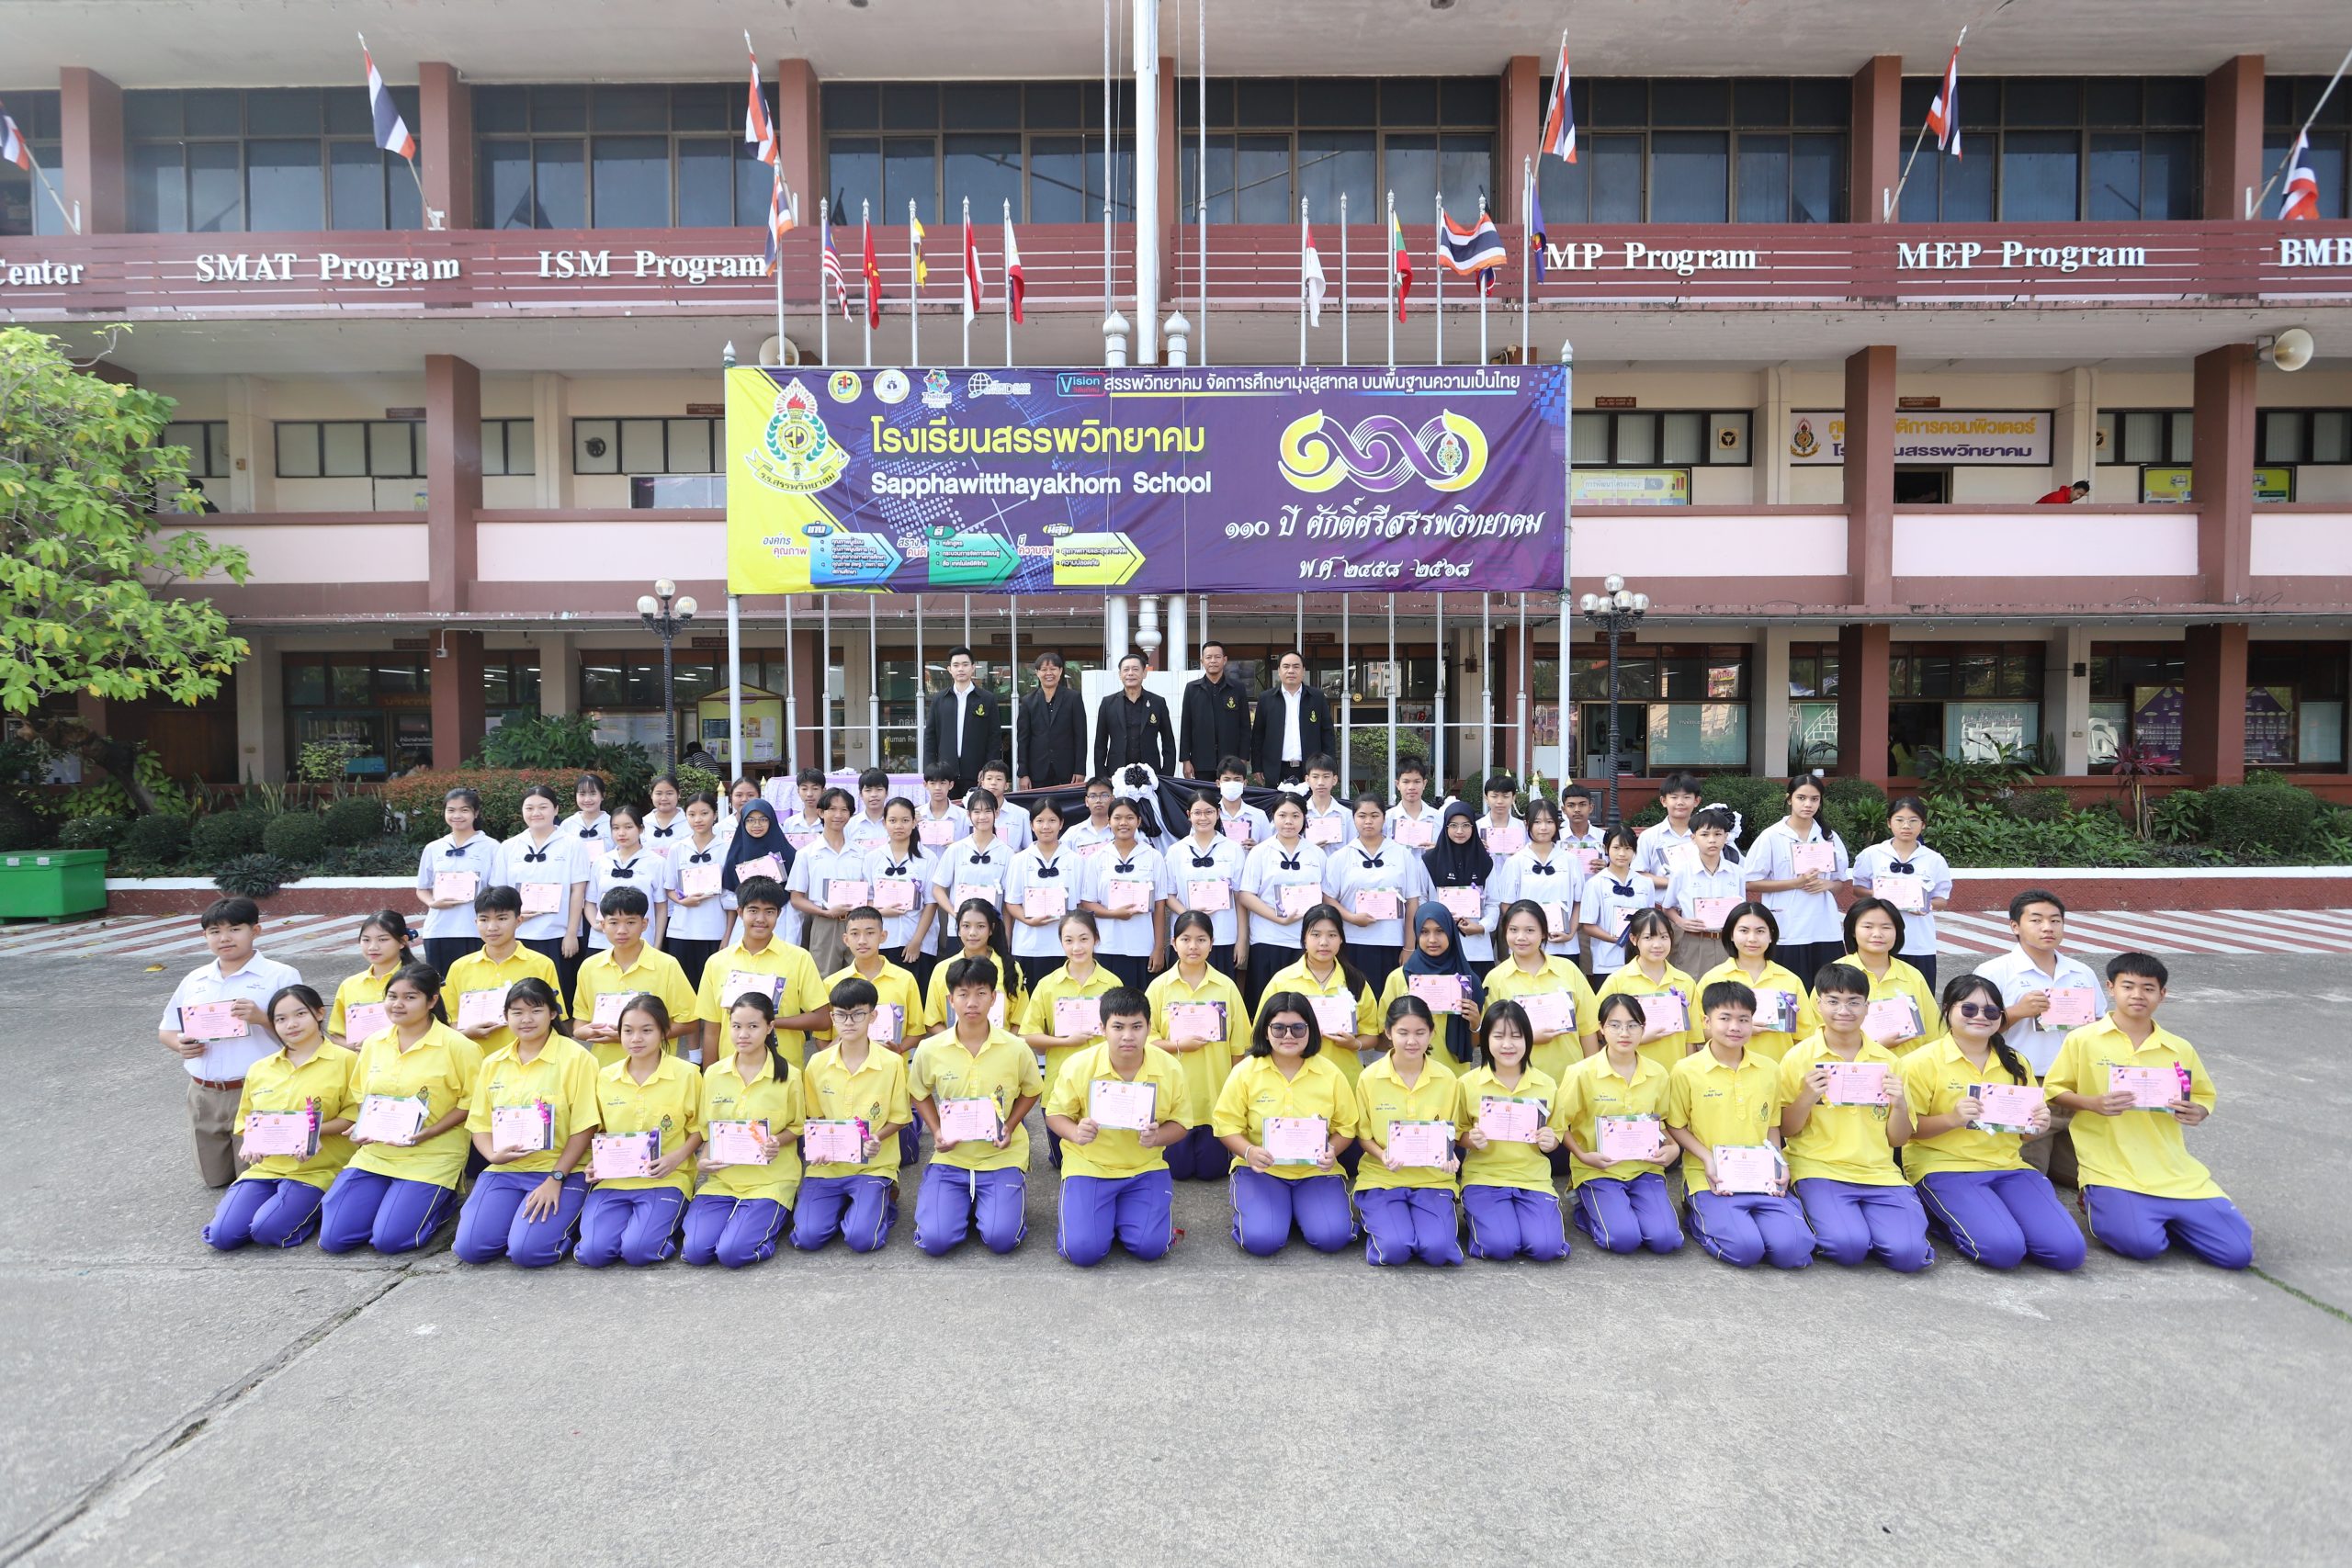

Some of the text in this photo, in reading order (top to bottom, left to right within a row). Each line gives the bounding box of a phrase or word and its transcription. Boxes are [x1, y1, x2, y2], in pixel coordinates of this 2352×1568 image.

[196, 253, 460, 287] SMAT Program
[538, 250, 768, 284] ISM Program
[1545, 242, 1756, 276] MP Program
[1897, 240, 2146, 273] MEP Program
[1060, 377, 1100, 393] Vision
[1104, 367, 1521, 395] สรรพวิทยาคม จัดการศึกษามุ่งสู่สากล บนพื้นฐานความเป็นไทย
[871, 416, 1204, 453] โรงเรียนสรรพวิทยาคม
[871, 470, 1212, 501] Sapphawitthayakhom School
[1225, 496, 1547, 539] ๑๑๐ ปี ศักดิ์ศรีสรรพวิทยาคม
[763, 532, 792, 547] องค์กร
[773, 547, 808, 558] คุณภาพ
[897, 532, 920, 547] สร้าง
[906, 546, 928, 558] คนดี
[1017, 534, 1026, 547] มี
[1018, 546, 1053, 558] ความสุข
